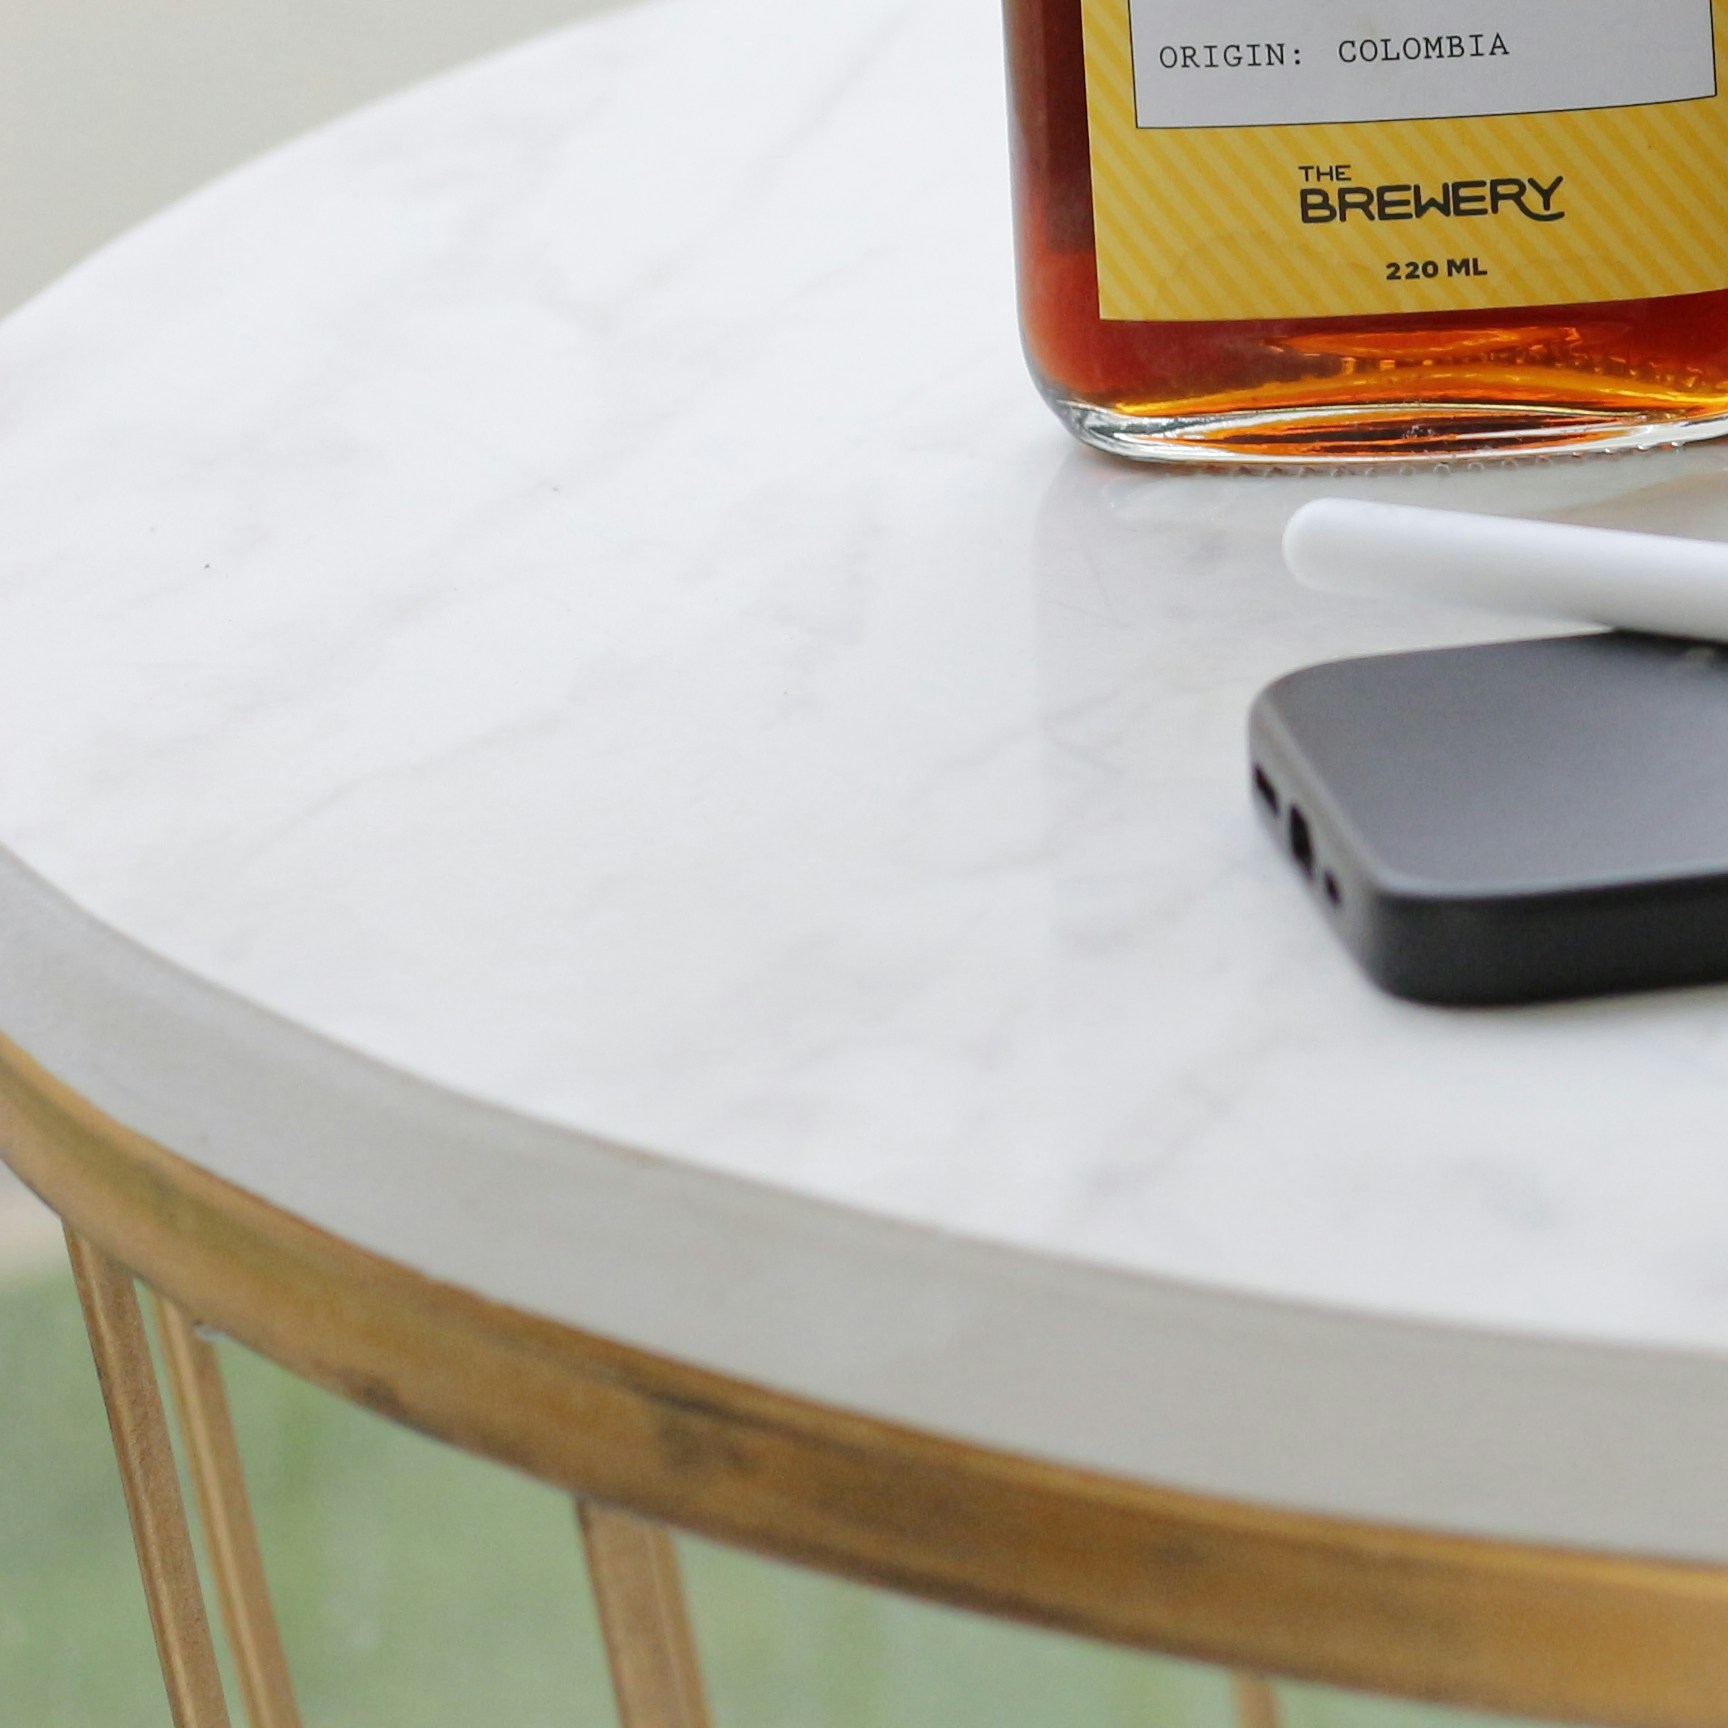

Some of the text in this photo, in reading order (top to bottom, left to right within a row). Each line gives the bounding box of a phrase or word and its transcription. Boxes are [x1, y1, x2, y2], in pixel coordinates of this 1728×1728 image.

[1159, 32, 1510, 69] ORIGIN: COLOMBIA
[1298, 164, 1352, 182] THE
[1300, 175, 1566, 223] BREWERY
[1386, 257, 1488, 281] 220 ML
